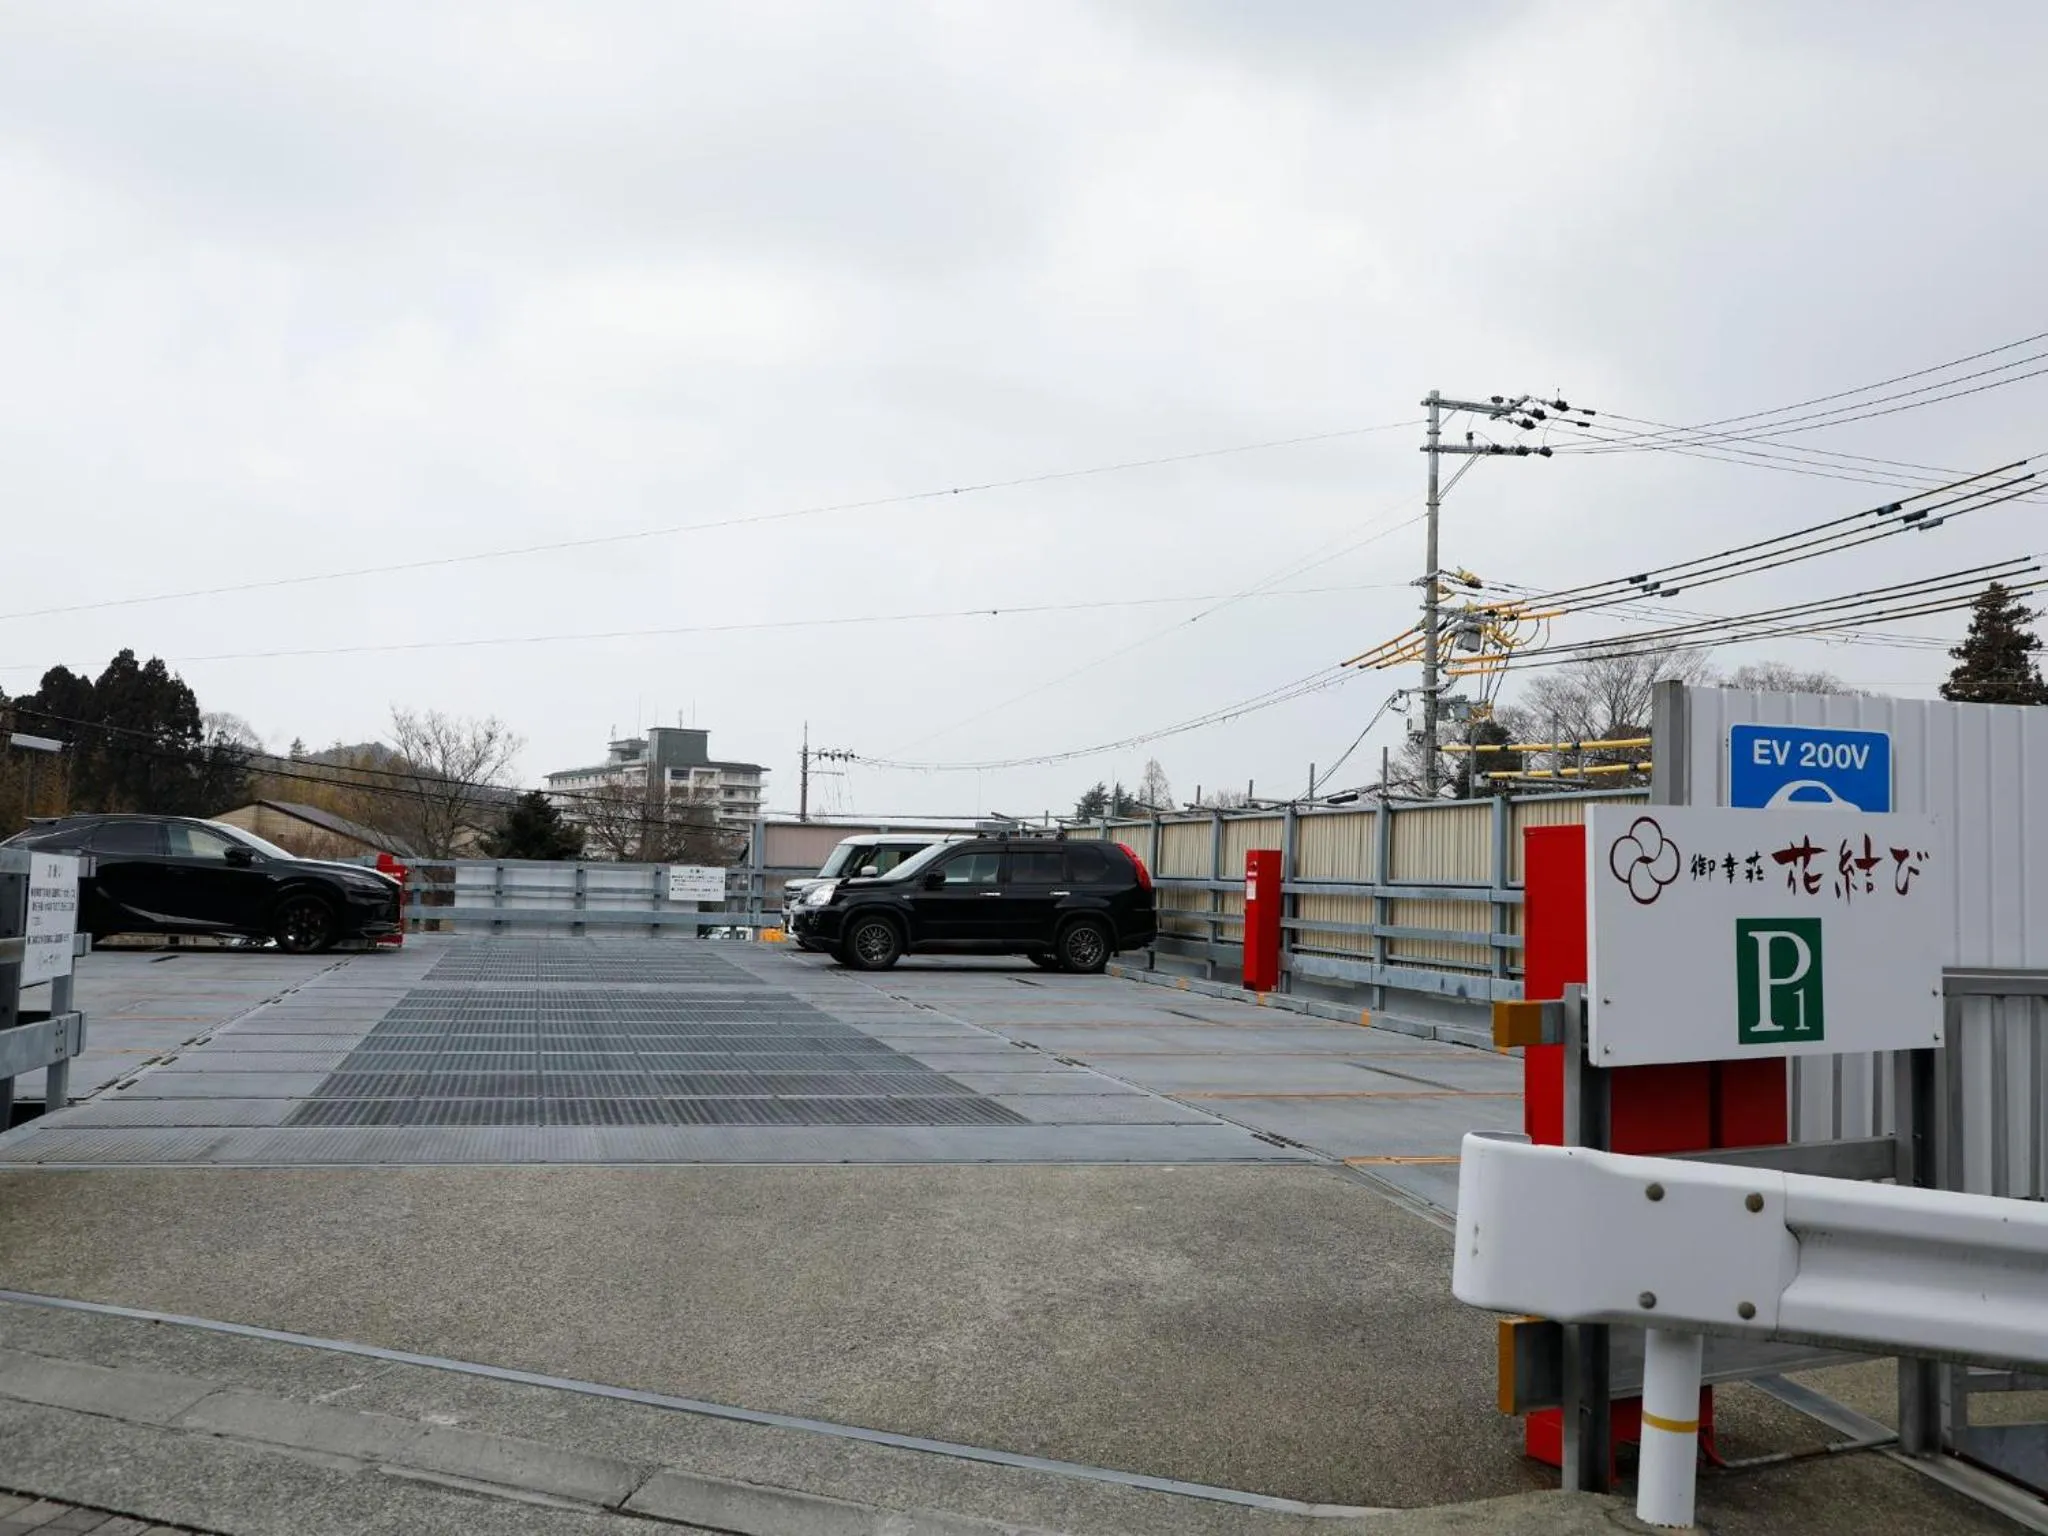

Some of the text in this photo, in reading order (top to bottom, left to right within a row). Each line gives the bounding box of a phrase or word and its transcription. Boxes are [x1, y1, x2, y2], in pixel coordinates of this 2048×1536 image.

[1753, 739, 1870, 770] EV 200V
[1691, 833, 1930, 905] 御幸荘 花結び
